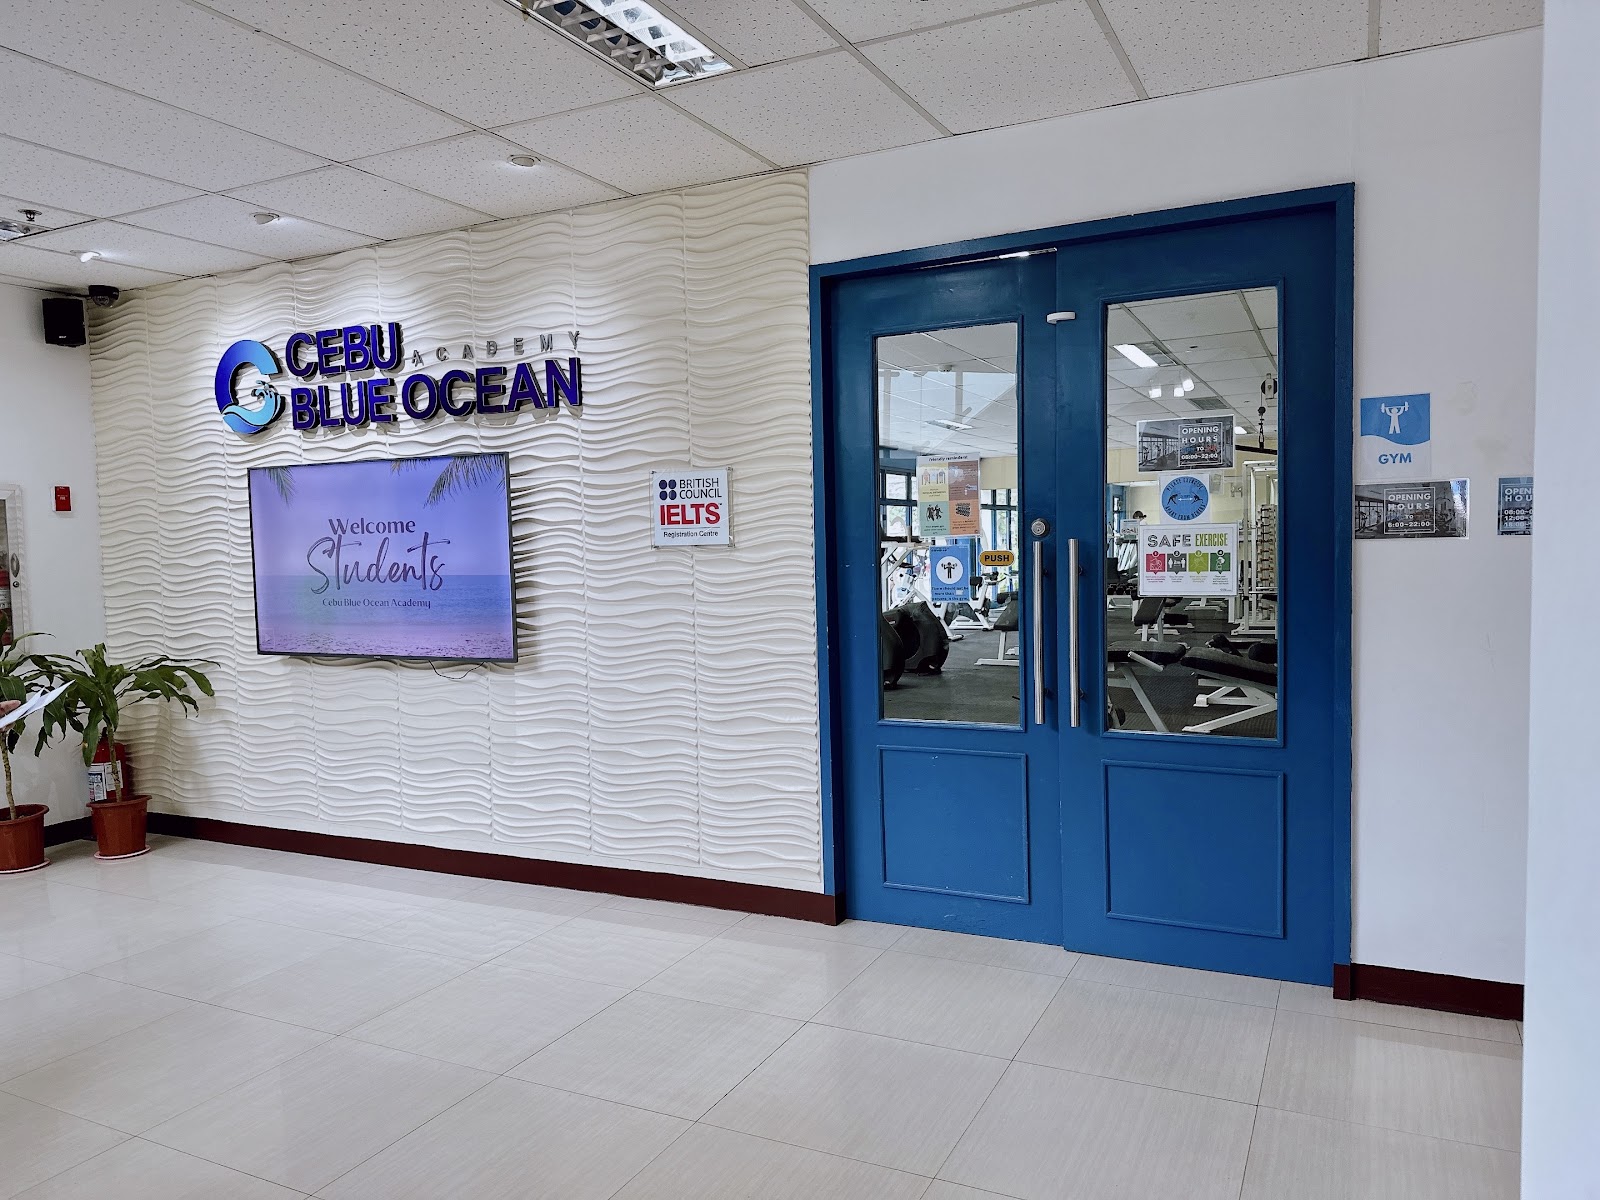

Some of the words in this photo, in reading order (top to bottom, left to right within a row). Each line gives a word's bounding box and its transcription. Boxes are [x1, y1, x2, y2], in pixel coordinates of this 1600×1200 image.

[285, 322, 401, 378] CEBU
[411, 330, 581, 367] ACADEMY
[291, 378, 398, 431] BLUE
[401, 357, 583, 420] OCEAN
[1182, 426, 1219, 434] OPENING
[1182, 435, 1218, 443] HOURS
[1378, 452, 1412, 465] GYM
[680, 478, 719, 489] BRITISH
[679, 488, 722, 499] COUNCIL
[1505, 487, 1533, 495] OPEN
[1388, 493, 1431, 501] OPENING
[1388, 502, 1430, 510] HOURS
[660, 502, 720, 525] IELTS
[328, 518, 416, 535] Welcome
[663, 531, 698, 539] Registration
[1147, 534, 1191, 547] SAFE
[1195, 533, 1228, 546] EXERCISE
[307, 532, 451, 594] Students
[984, 554, 1010, 562] PUSH
[322, 598, 343, 607] Cebu
[344, 598, 361, 607] Blue
[363, 598, 389, 607] Ocean
[391, 598, 431, 609] Academy
